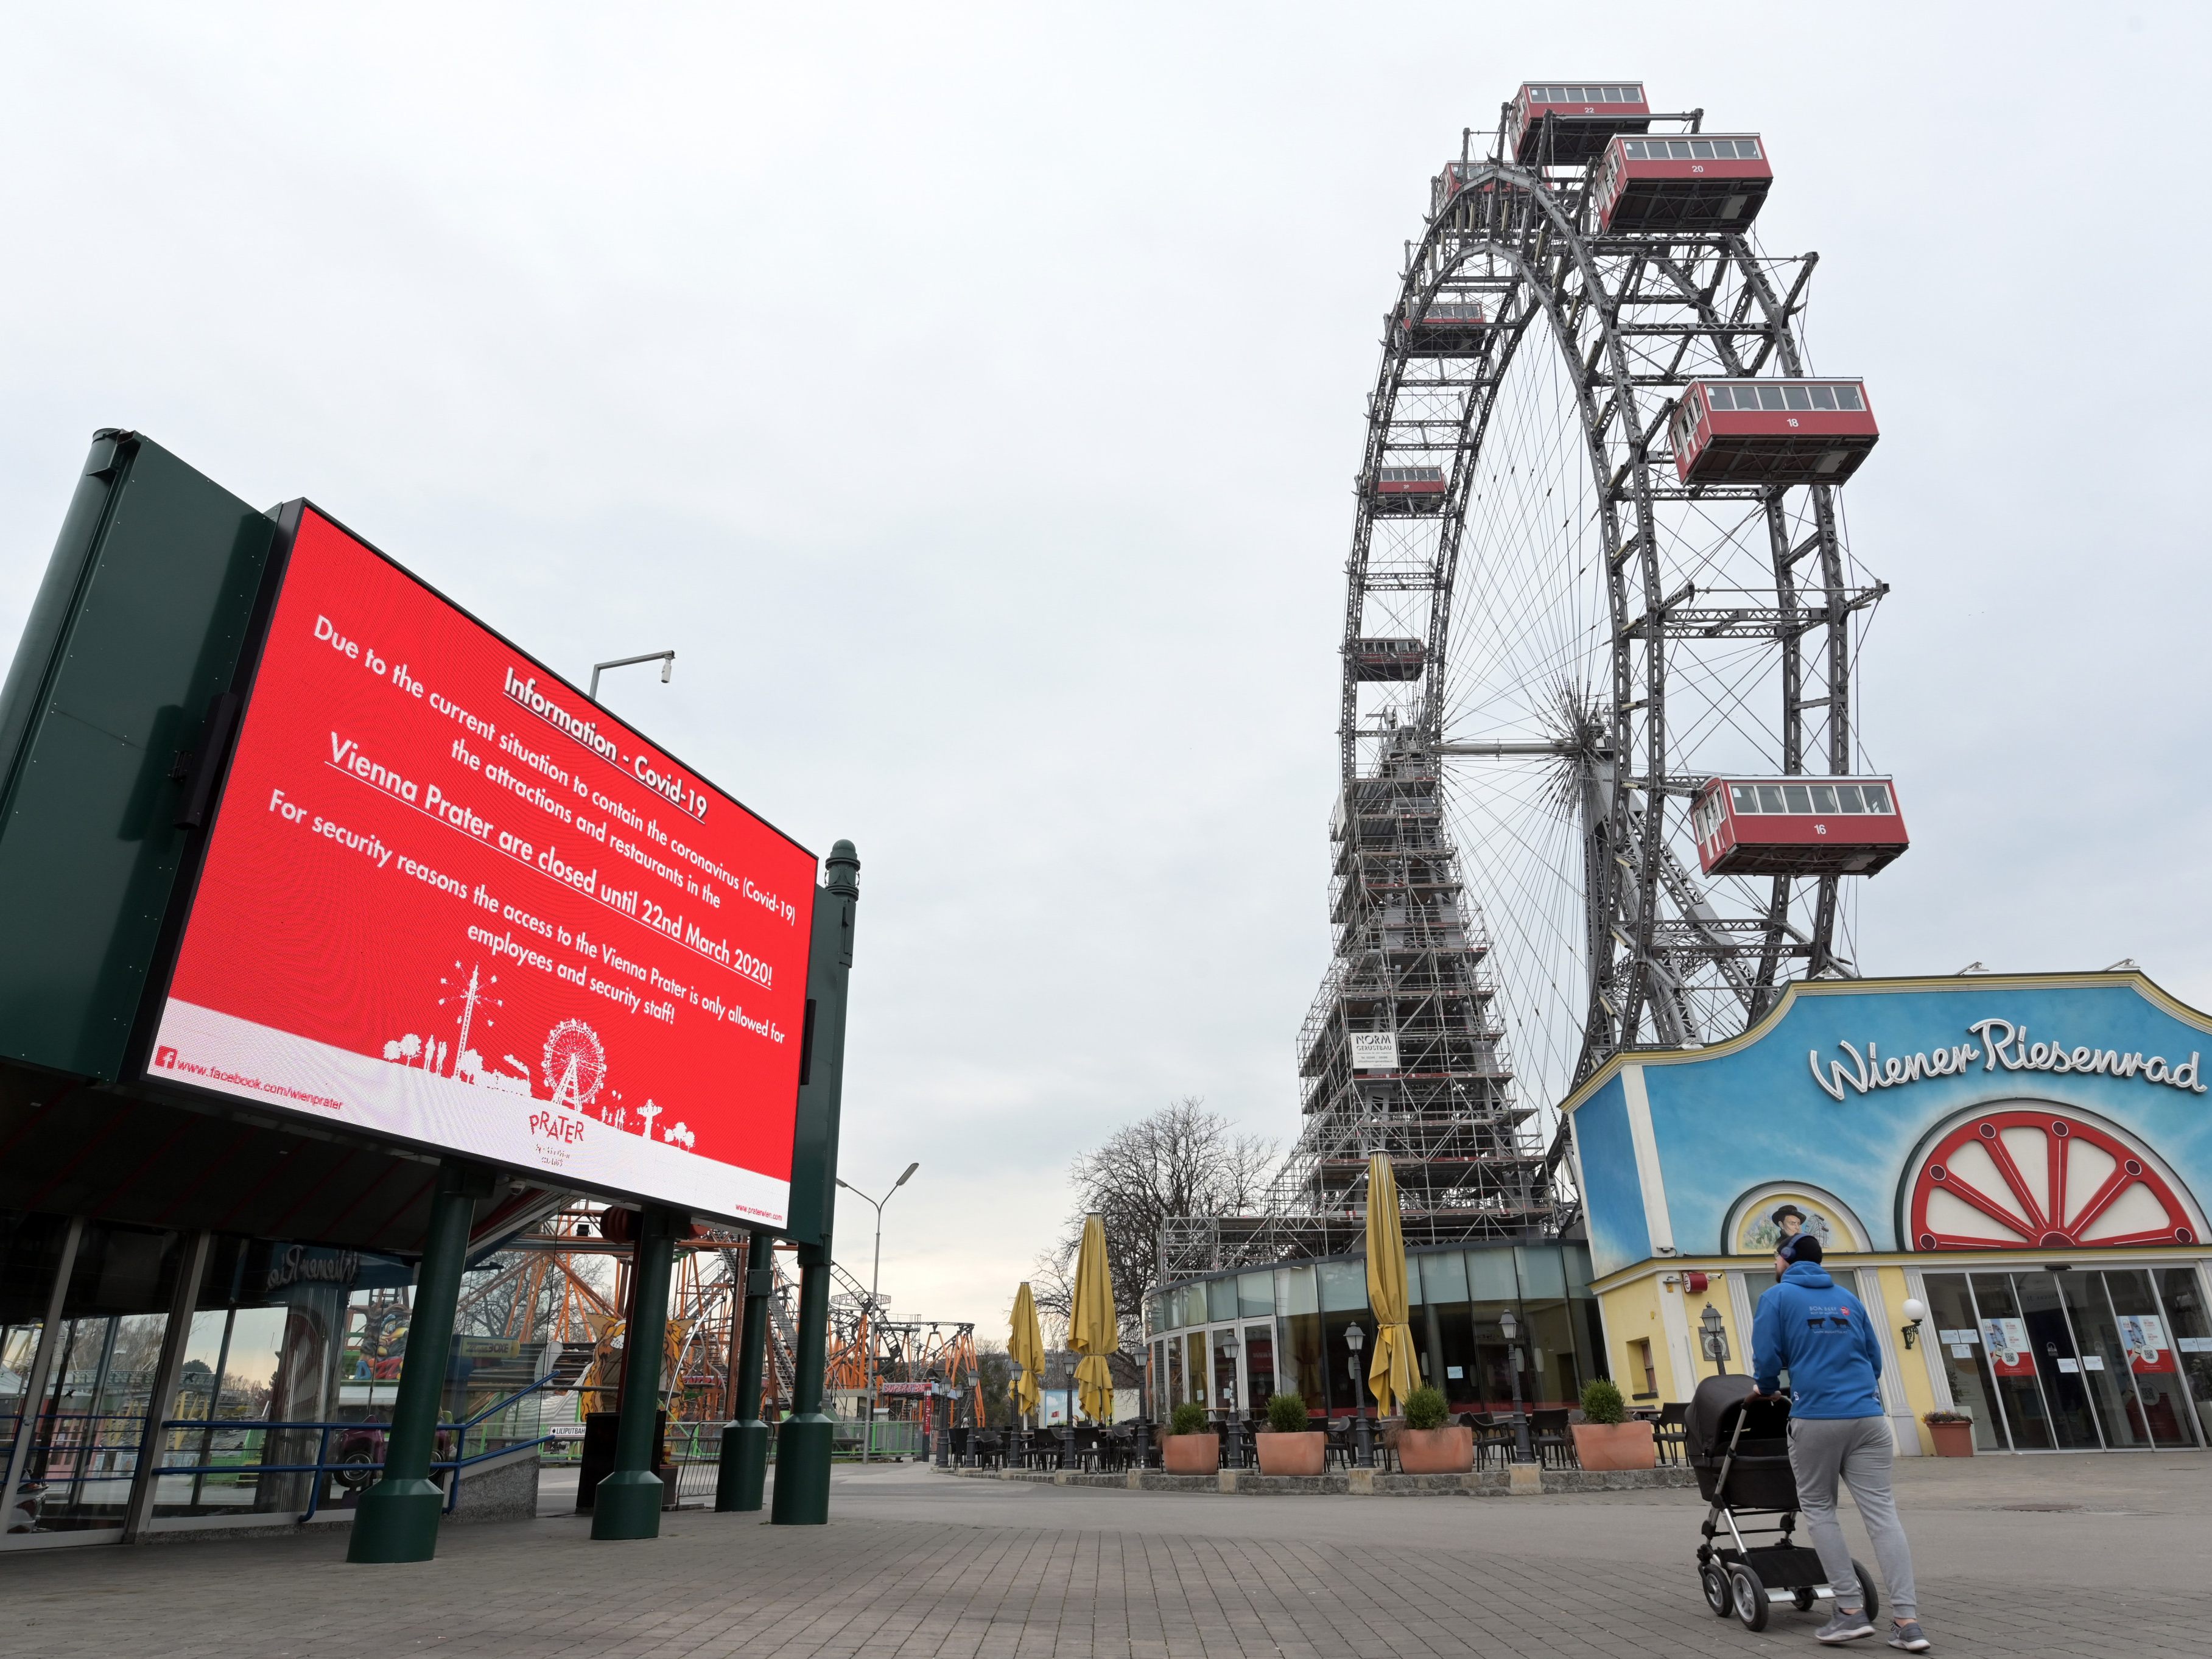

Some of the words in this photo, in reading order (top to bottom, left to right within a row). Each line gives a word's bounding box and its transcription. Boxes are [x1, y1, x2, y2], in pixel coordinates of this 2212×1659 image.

[1786, 418, 1799, 427] 18
[314, 614, 359, 659] Due
[365, 648, 387, 675] to
[392, 664, 424, 698] the
[429, 693, 496, 742] current
[499, 732, 569, 787] situation
[573, 775, 588, 798] to
[592, 791, 644, 832] contain
[647, 819, 668, 846] the
[670, 840, 739, 890] coronavirus
[743, 877, 795, 927] (Covid-19)
[504, 667, 617, 761] Information
[634, 755, 707, 818] Covid-19
[331, 731, 418, 802] Vienna
[424, 784, 494, 839] Prater
[499, 831, 533, 861] are
[538, 846, 597, 894] closed
[600, 884, 638, 916] until
[641, 899, 683, 939] 22nd
[685, 922, 730, 964] March
[734, 949, 773, 986] 2020!
[451, 738, 480, 771] the
[485, 764, 572, 824] attractions
[576, 816, 607, 843] and
[609, 835, 684, 888] restaurants
[687, 874, 698, 896] in
[702, 883, 720, 908] the
[1814, 824, 1827, 835] 16
[269, 788, 307, 824] For
[312, 816, 393, 868] security
[396, 855, 468, 899] reasons
[473, 884, 499, 913] the
[503, 905, 553, 938] access
[557, 925, 572, 946] to
[575, 931, 597, 958] the
[602, 943, 647, 981] Vienna
[650, 967, 687, 999] Prater
[689, 986, 698, 1005] is
[701, 995, 726, 1021] only
[728, 1005, 769, 1037] allowed
[770, 1022, 785, 1044] for
[467, 925, 553, 973] employees
[557, 964, 587, 986] and
[589, 978, 641, 1014] security
[644, 1000, 675, 1025] staff!
[1356, 1035, 1391, 1044] NORM
[1809, 1039, 1979, 1101] Wiener
[1967, 1018, 2208, 1093] Riesenrad
[176, 1060, 344, 1111] www.facebook.com/wienprater
[529, 1110, 584, 1144] PRATER
[735, 1204, 783, 1221] www.praterwien.com
